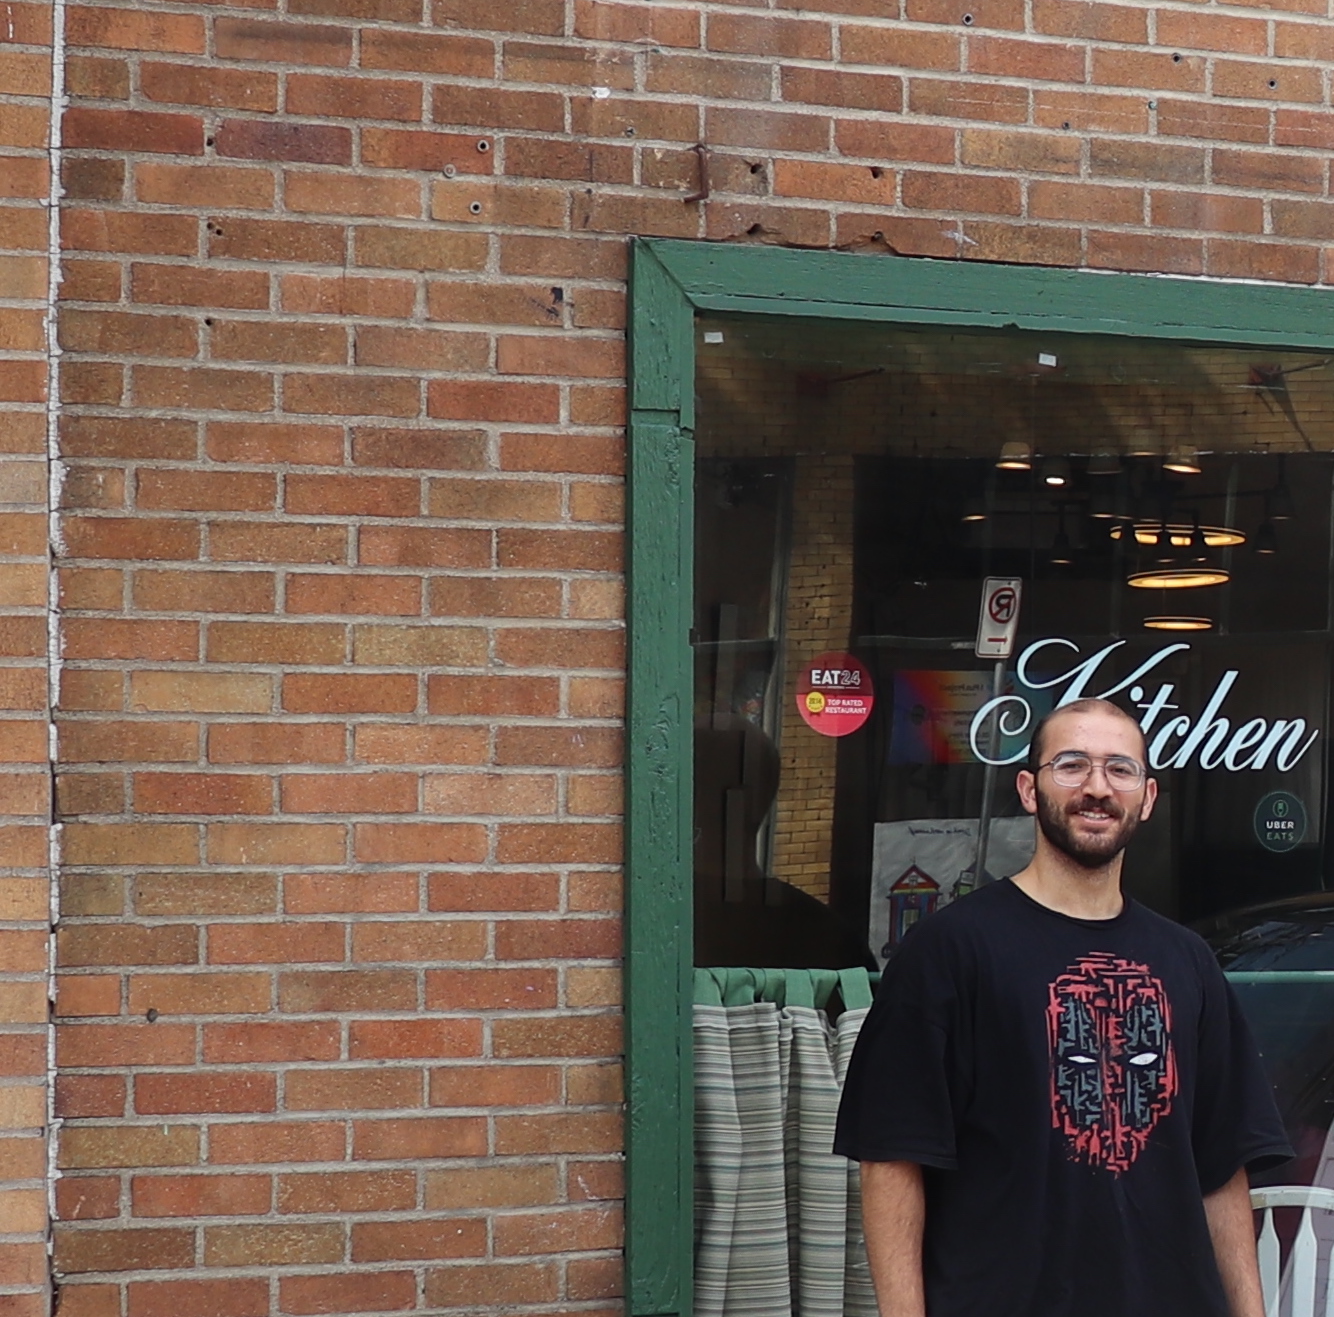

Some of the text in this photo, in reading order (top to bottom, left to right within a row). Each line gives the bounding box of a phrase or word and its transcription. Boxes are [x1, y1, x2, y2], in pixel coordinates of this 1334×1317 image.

[810, 669, 861, 686] EAT24
[827, 698, 864, 707] TOP RATED
[825, 706, 867, 714] RESTAURANT
[1265, 820, 1295, 830] UBER
[1265, 831, 1295, 841] EATS
